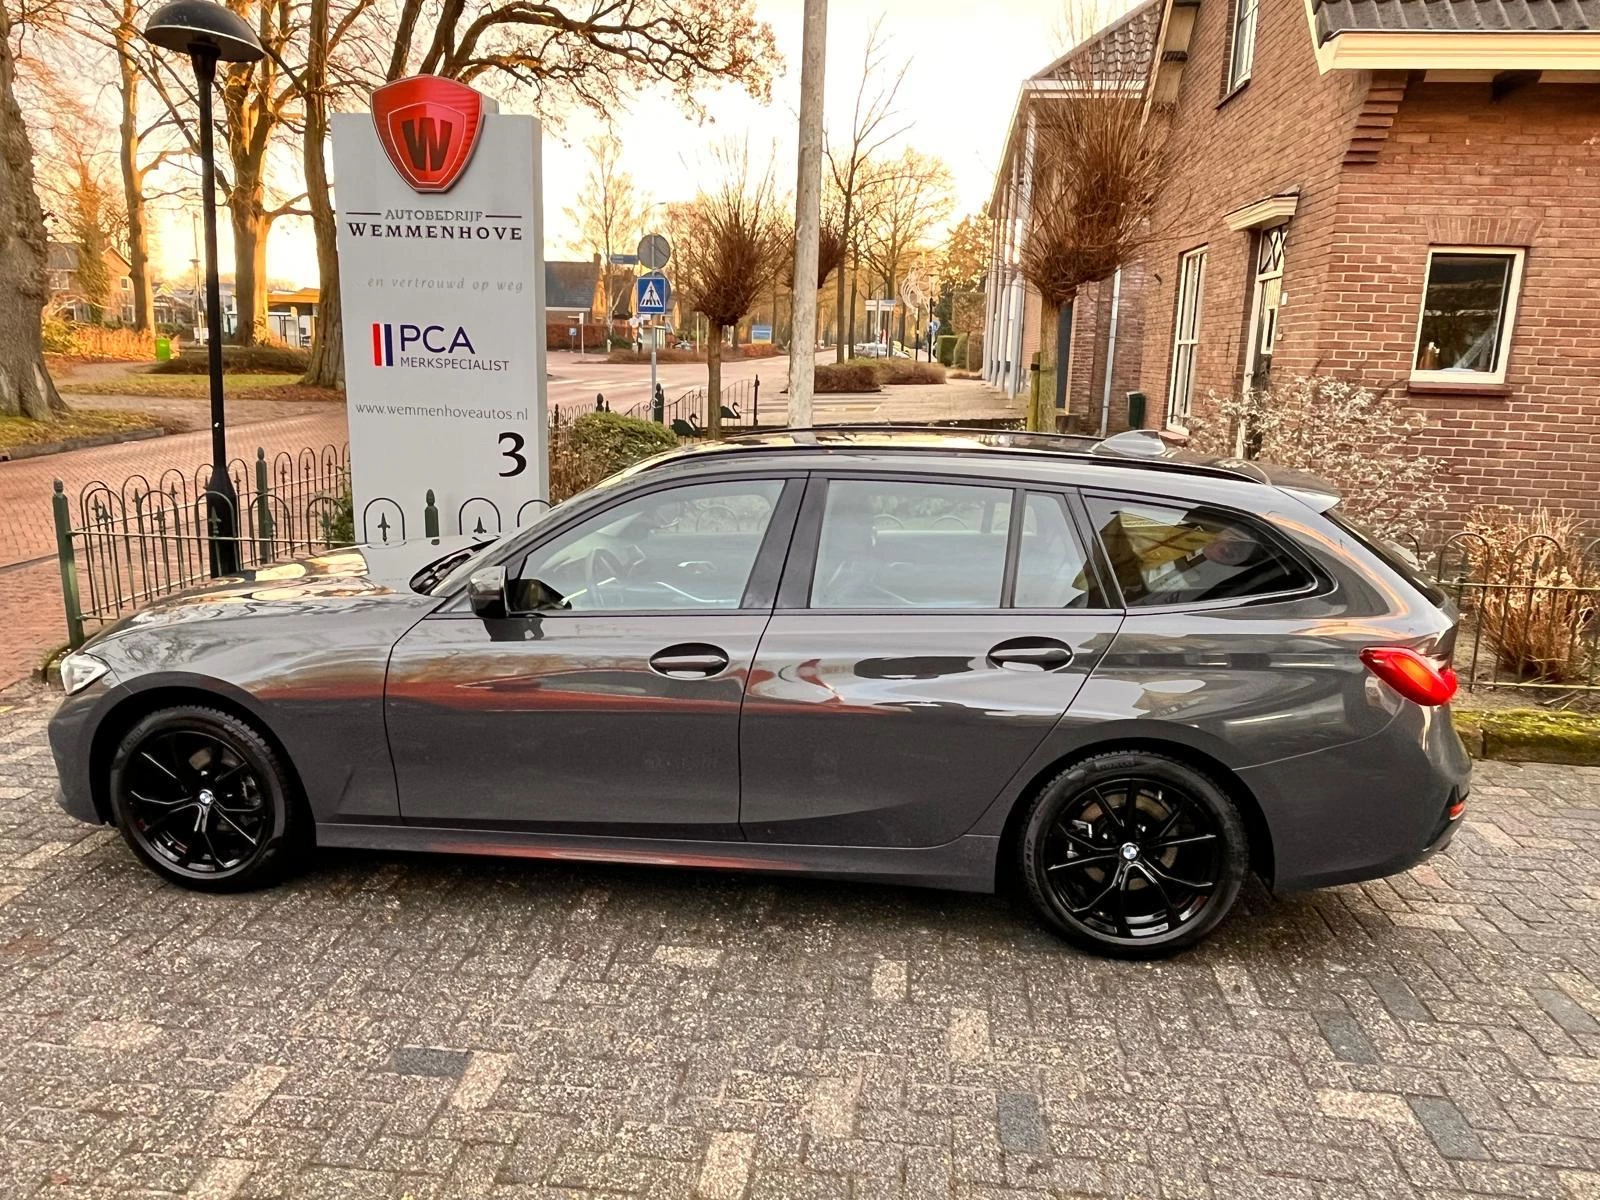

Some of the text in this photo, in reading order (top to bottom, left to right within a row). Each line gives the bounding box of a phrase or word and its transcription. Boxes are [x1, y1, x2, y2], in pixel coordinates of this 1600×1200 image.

[384, 209, 483, 222] AUTOBEDRIJF
[346, 222, 522, 241] WEMMENHOVE
[392, 277, 465, 290] vertrouwd
[472, 279, 489, 292] op
[497, 280, 523, 294] weg
[400, 324, 476, 354] PCA
[400, 357, 510, 372] MERKSPECIALIST
[355, 403, 528, 421] www.wemmenhoveautos.nl
[498, 431, 527, 478] 3
